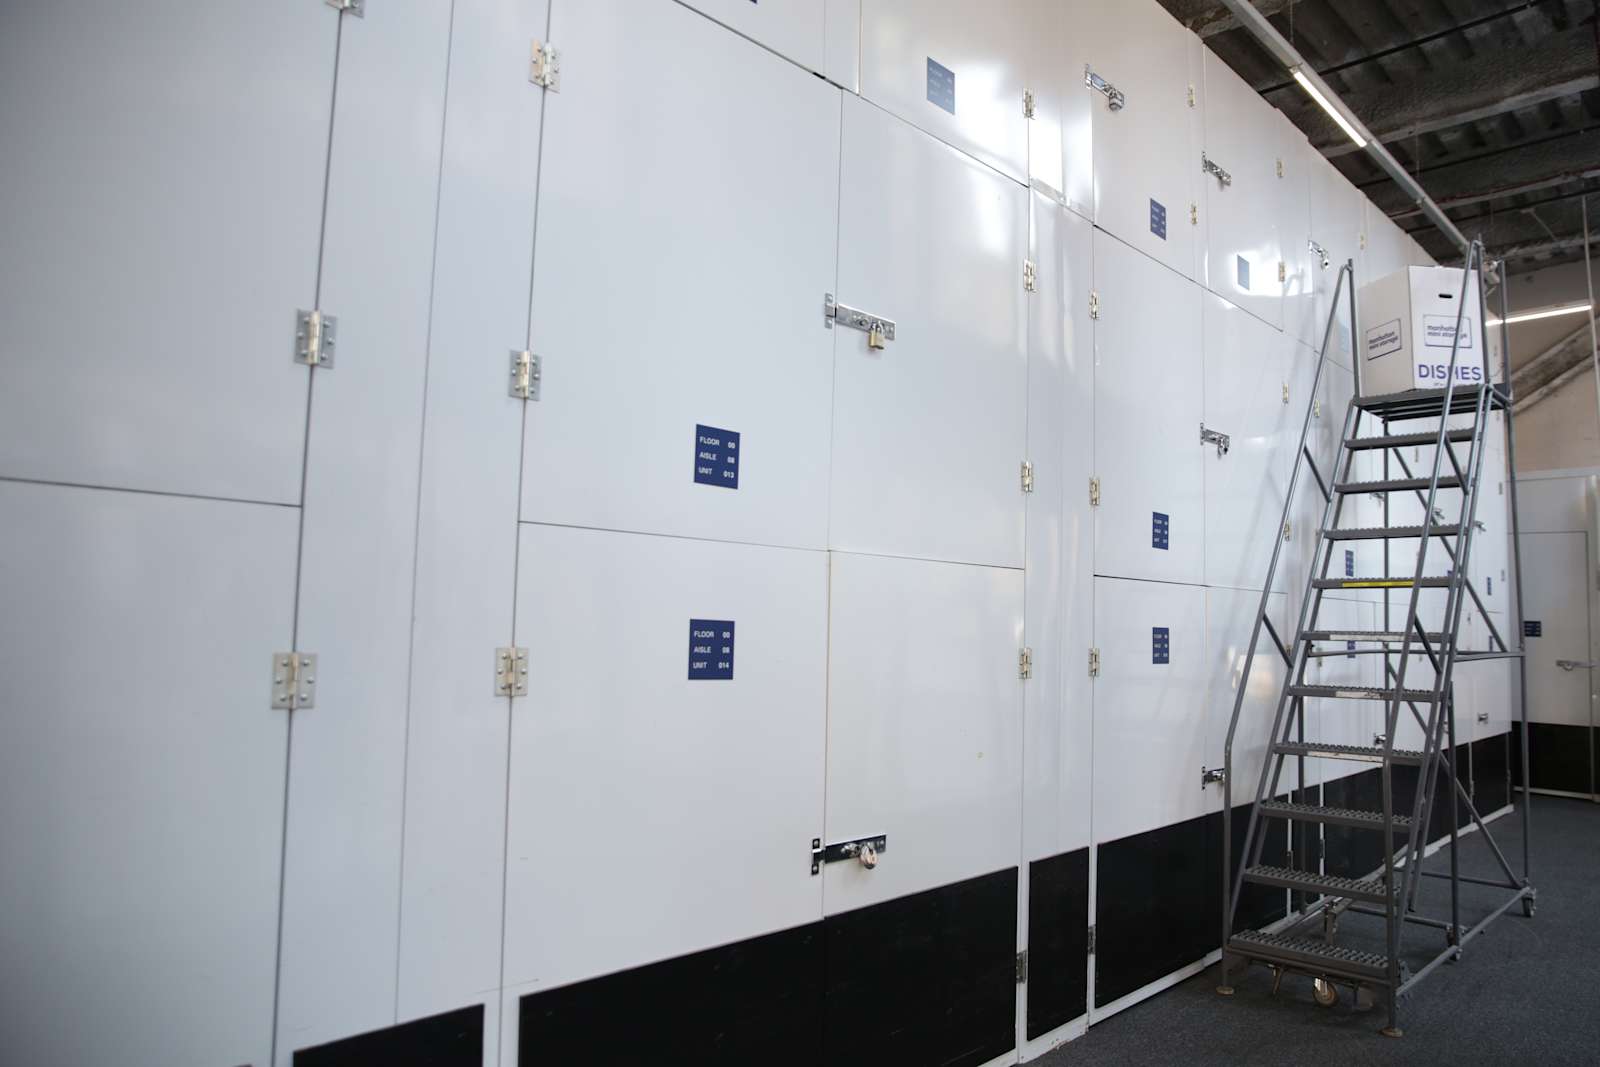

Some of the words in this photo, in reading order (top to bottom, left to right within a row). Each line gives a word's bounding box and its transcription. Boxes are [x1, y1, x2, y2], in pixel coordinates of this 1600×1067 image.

[1442, 332, 1467, 340] storge
[699, 436, 720, 446] FLOOR
[699, 451, 717, 461] AISLE
[698, 466, 713, 475] UNIT
[693, 630, 715, 638] FLOOR
[693, 646, 712, 654] AISLE
[692, 661, 708, 669] UNIT
